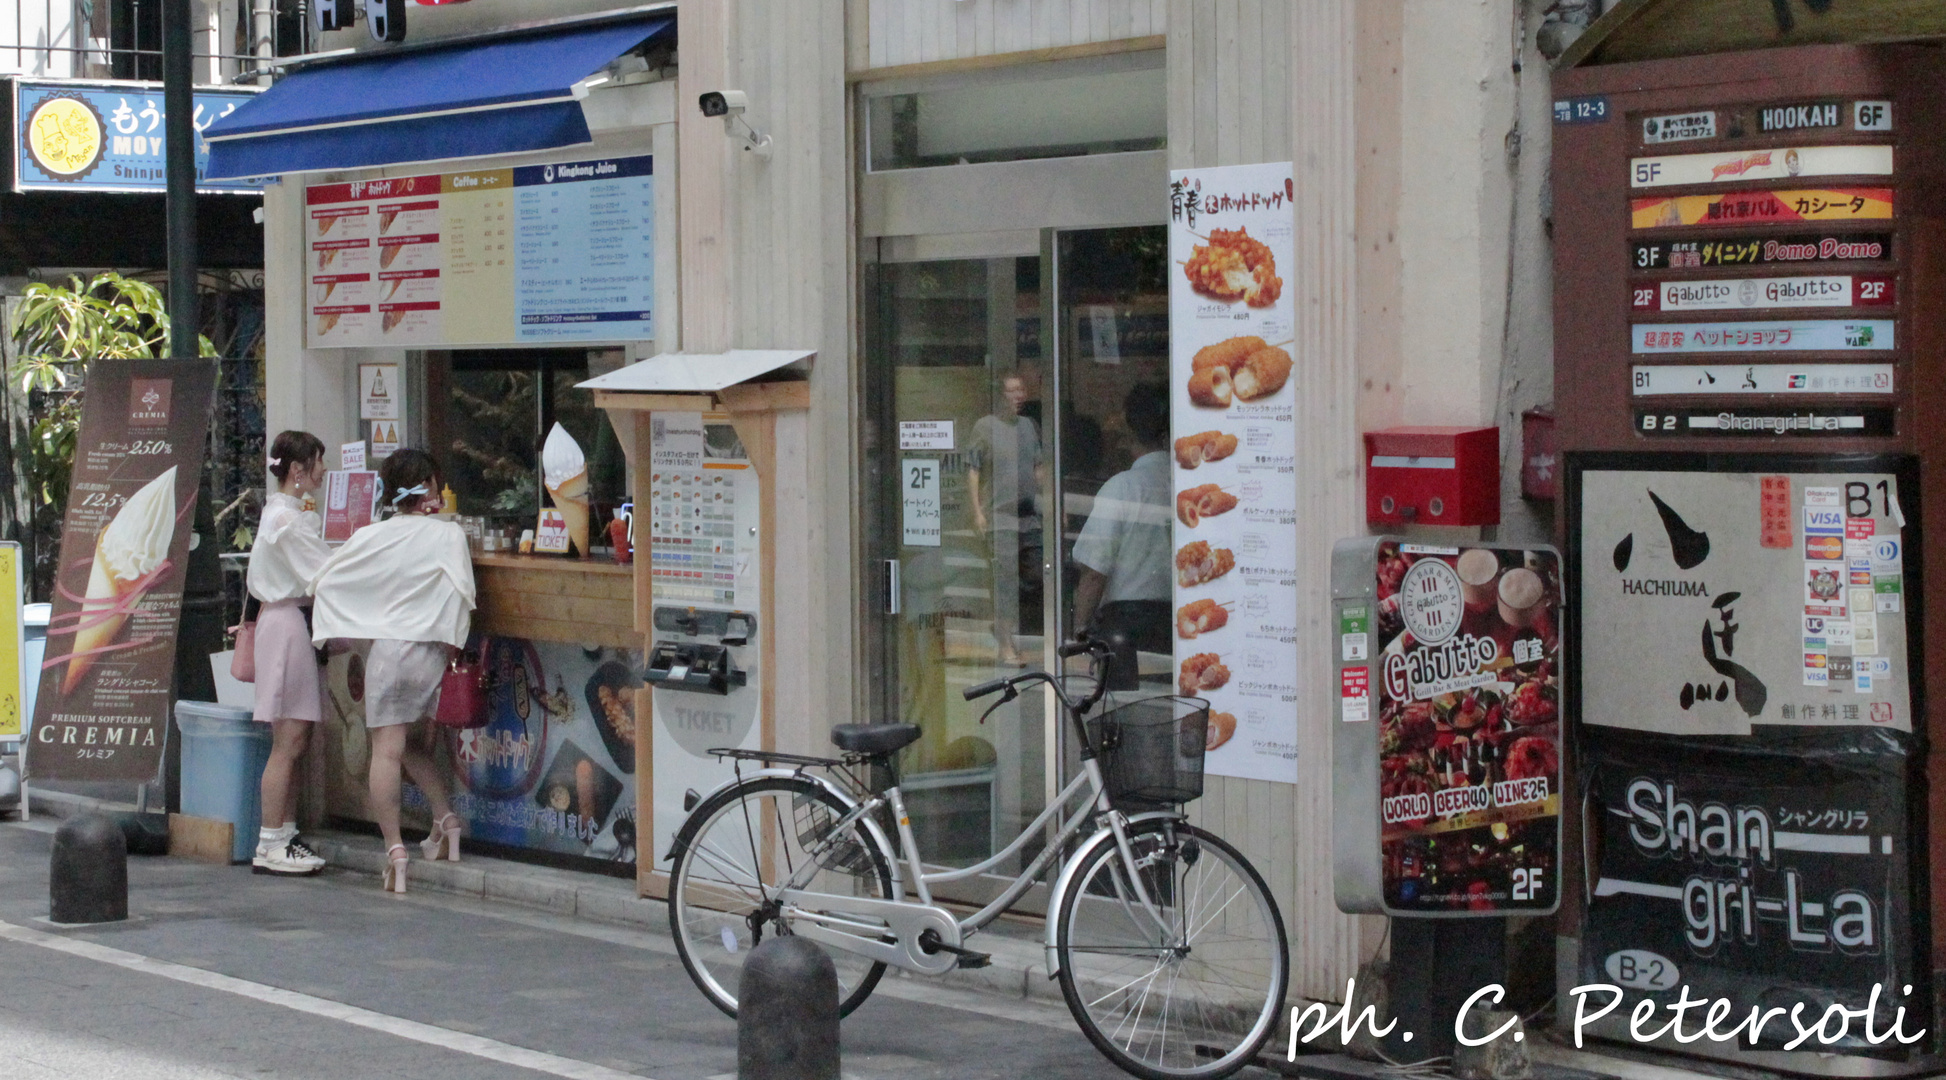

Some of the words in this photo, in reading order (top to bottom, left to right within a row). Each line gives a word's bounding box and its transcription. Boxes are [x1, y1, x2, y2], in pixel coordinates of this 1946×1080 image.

[1577, 102, 1605, 117] 12-3
[1763, 104, 1838, 130] HOOKAH
[1859, 105, 1883, 126] 6F
[1661, 127, 1712, 140] 水タバコカフェ
[113, 136, 163, 156] MOY
[114, 164, 167, 179] Shinju
[558, 164, 594, 177] Kingkong
[595, 161, 617, 174] Juice
[1636, 163, 1661, 183] 5F
[453, 176, 478, 187] Coffee
[1220, 190, 1284, 212] ホットドッグ
[1795, 196, 1866, 214] カシータ
[1637, 247, 1660, 267] 3F
[1702, 240, 1760, 264] ダイニング
[1764, 240, 1817, 260] Domo
[1819, 238, 1882, 259] Domo
[1634, 289, 1654, 306] 2F
[1667, 284, 1730, 306] Gabutto
[1766, 280, 1842, 302] Gabutto
[1860, 282, 1885, 298] 2F
[1694, 328, 1791, 347] ペットショップ
[1635, 372, 1650, 387] B1
[100, 442, 129, 451] 生クリーム
[128, 440, 173, 455] 25.0%
[343, 454, 364, 465] SALE
[911, 466, 931, 489] 2F
[903, 499, 933, 507] イートイン
[1845, 480, 1890, 518] B1
[916, 509, 940, 518] スペース
[1808, 512, 1842, 525] VISA
[921, 528, 940, 536] あります
[538, 535, 567, 548] TICKET
[1807, 543, 1842, 552] MasterCard
[1622, 579, 1709, 597] HACHIUMA
[1806, 617, 1824, 628] UC
[1386, 636, 1496, 702] Gabutto
[1512, 638, 1545, 664] 個室
[1807, 672, 1827, 680] VISA
[97, 678, 159, 687] ラングドシャコーン
[1416, 686, 1432, 697] Grill
[1433, 684, 1445, 693] Bar
[1454, 680, 1470, 688] Meat
[1471, 674, 1495, 684] Garden
[51, 714, 96, 723] PREMIUM
[98, 715, 151, 723] SOFTCREAM
[1781, 703, 1859, 720] 創作料理
[674, 707, 737, 735] TICKET
[39, 725, 155, 746] CREMIA
[77, 749, 115, 759] クレミア
[1384, 796, 1430, 821] WORLD
[1626, 779, 1771, 862] Shan
[1779, 807, 1869, 829] シャングリラ
[1513, 868, 1543, 900] 2F
[1619, 954, 1664, 986] B-2
